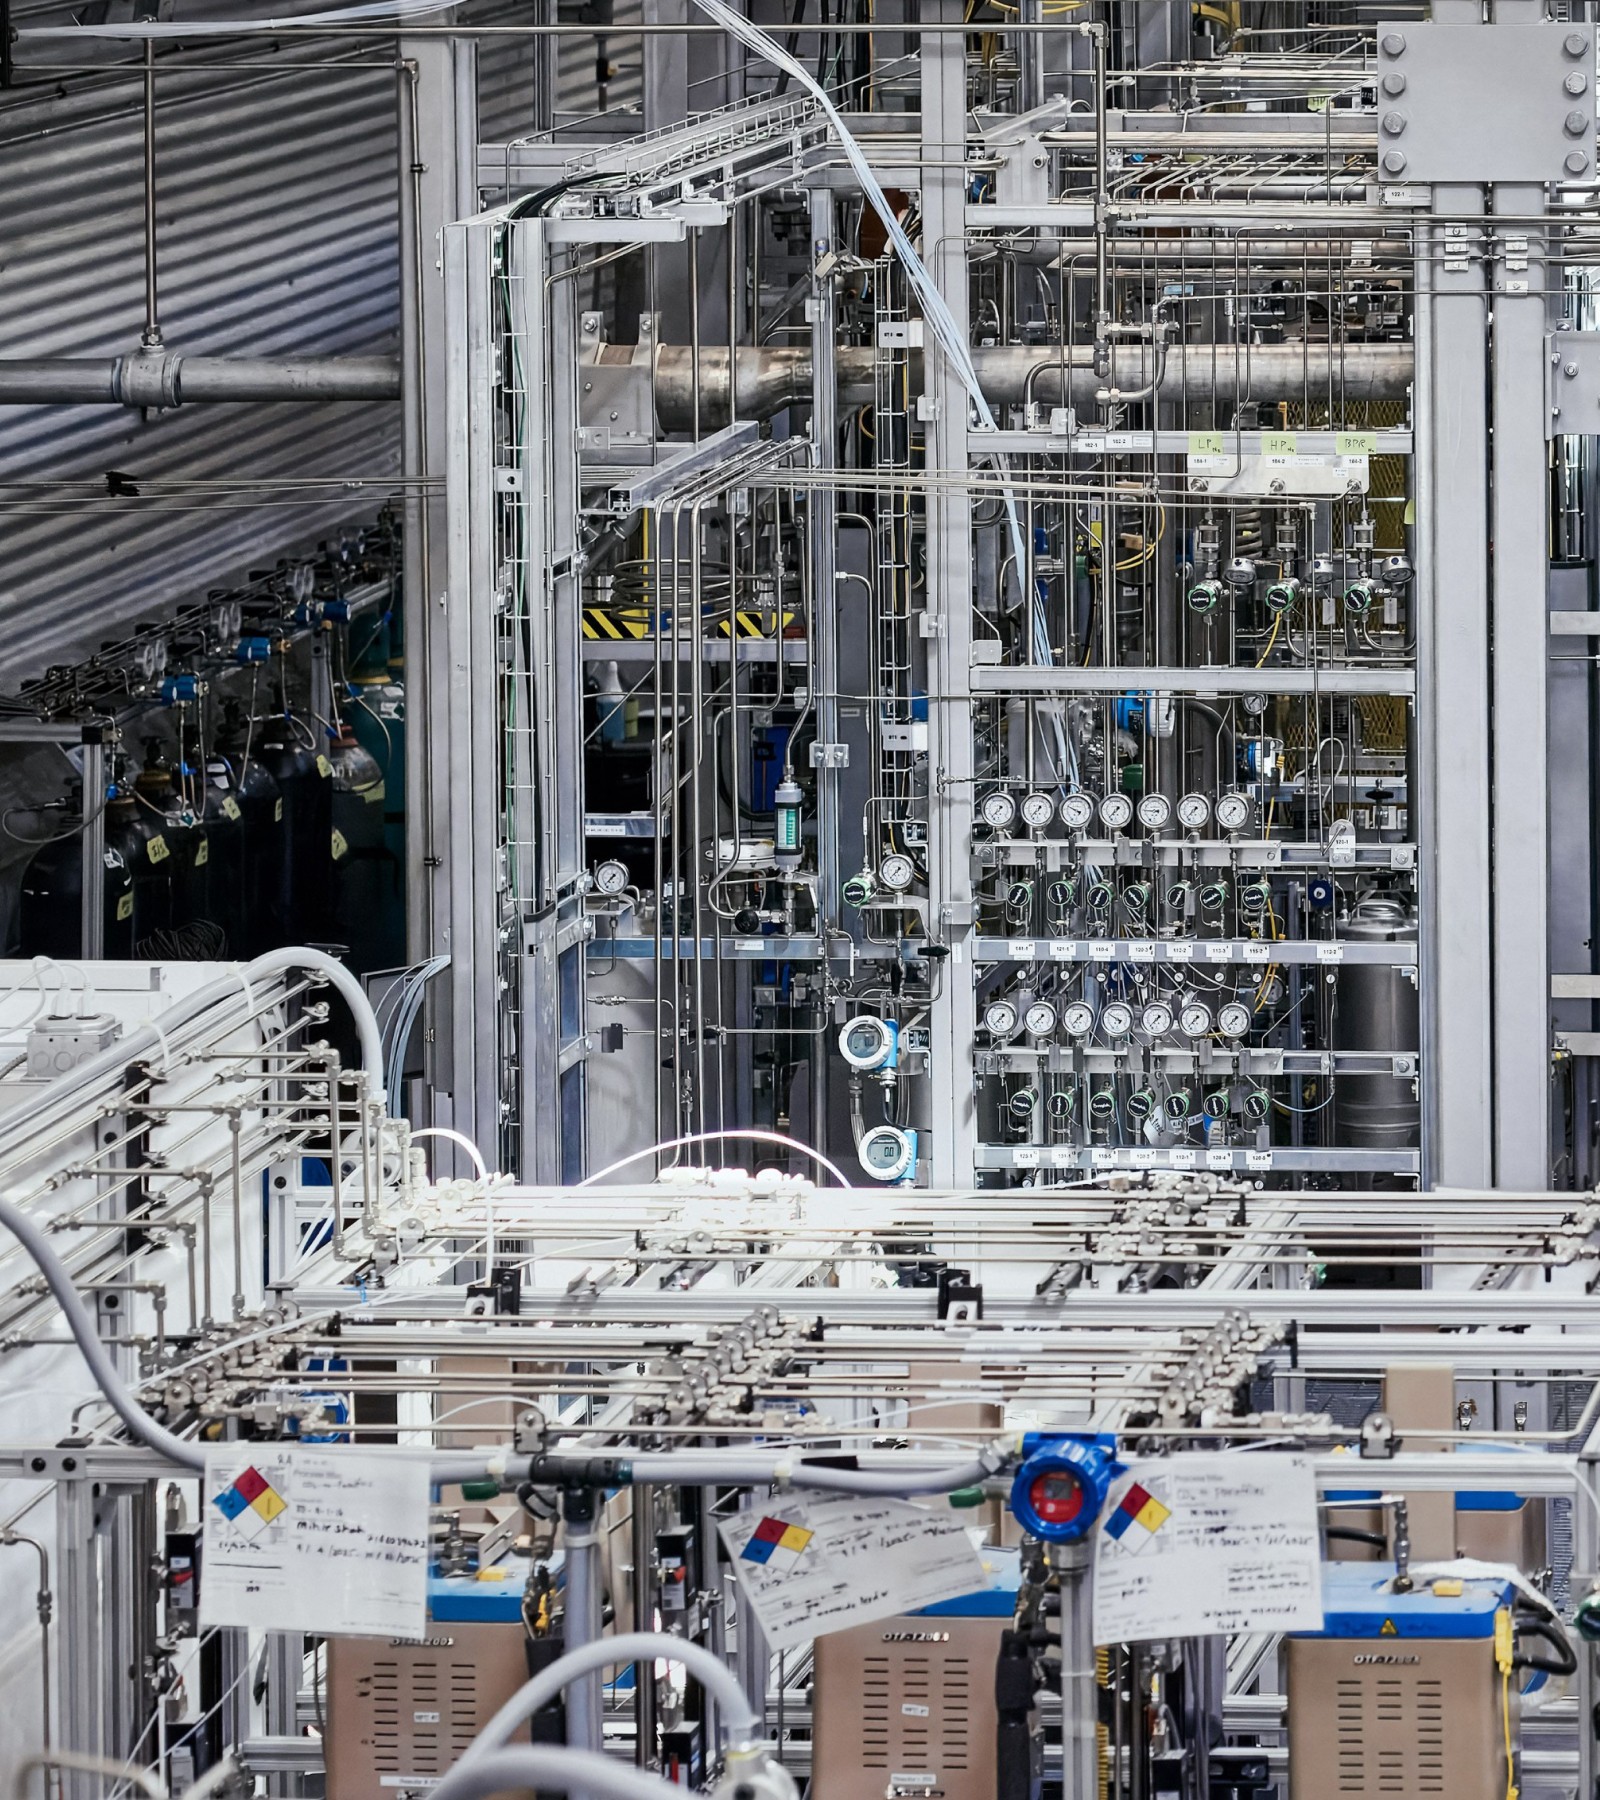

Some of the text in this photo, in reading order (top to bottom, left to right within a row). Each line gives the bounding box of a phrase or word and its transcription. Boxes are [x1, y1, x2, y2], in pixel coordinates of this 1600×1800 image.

[1198, 438, 1212, 450] LP
[1270, 439, 1287, 450] HP
[1344, 437, 1366, 449] BPR
